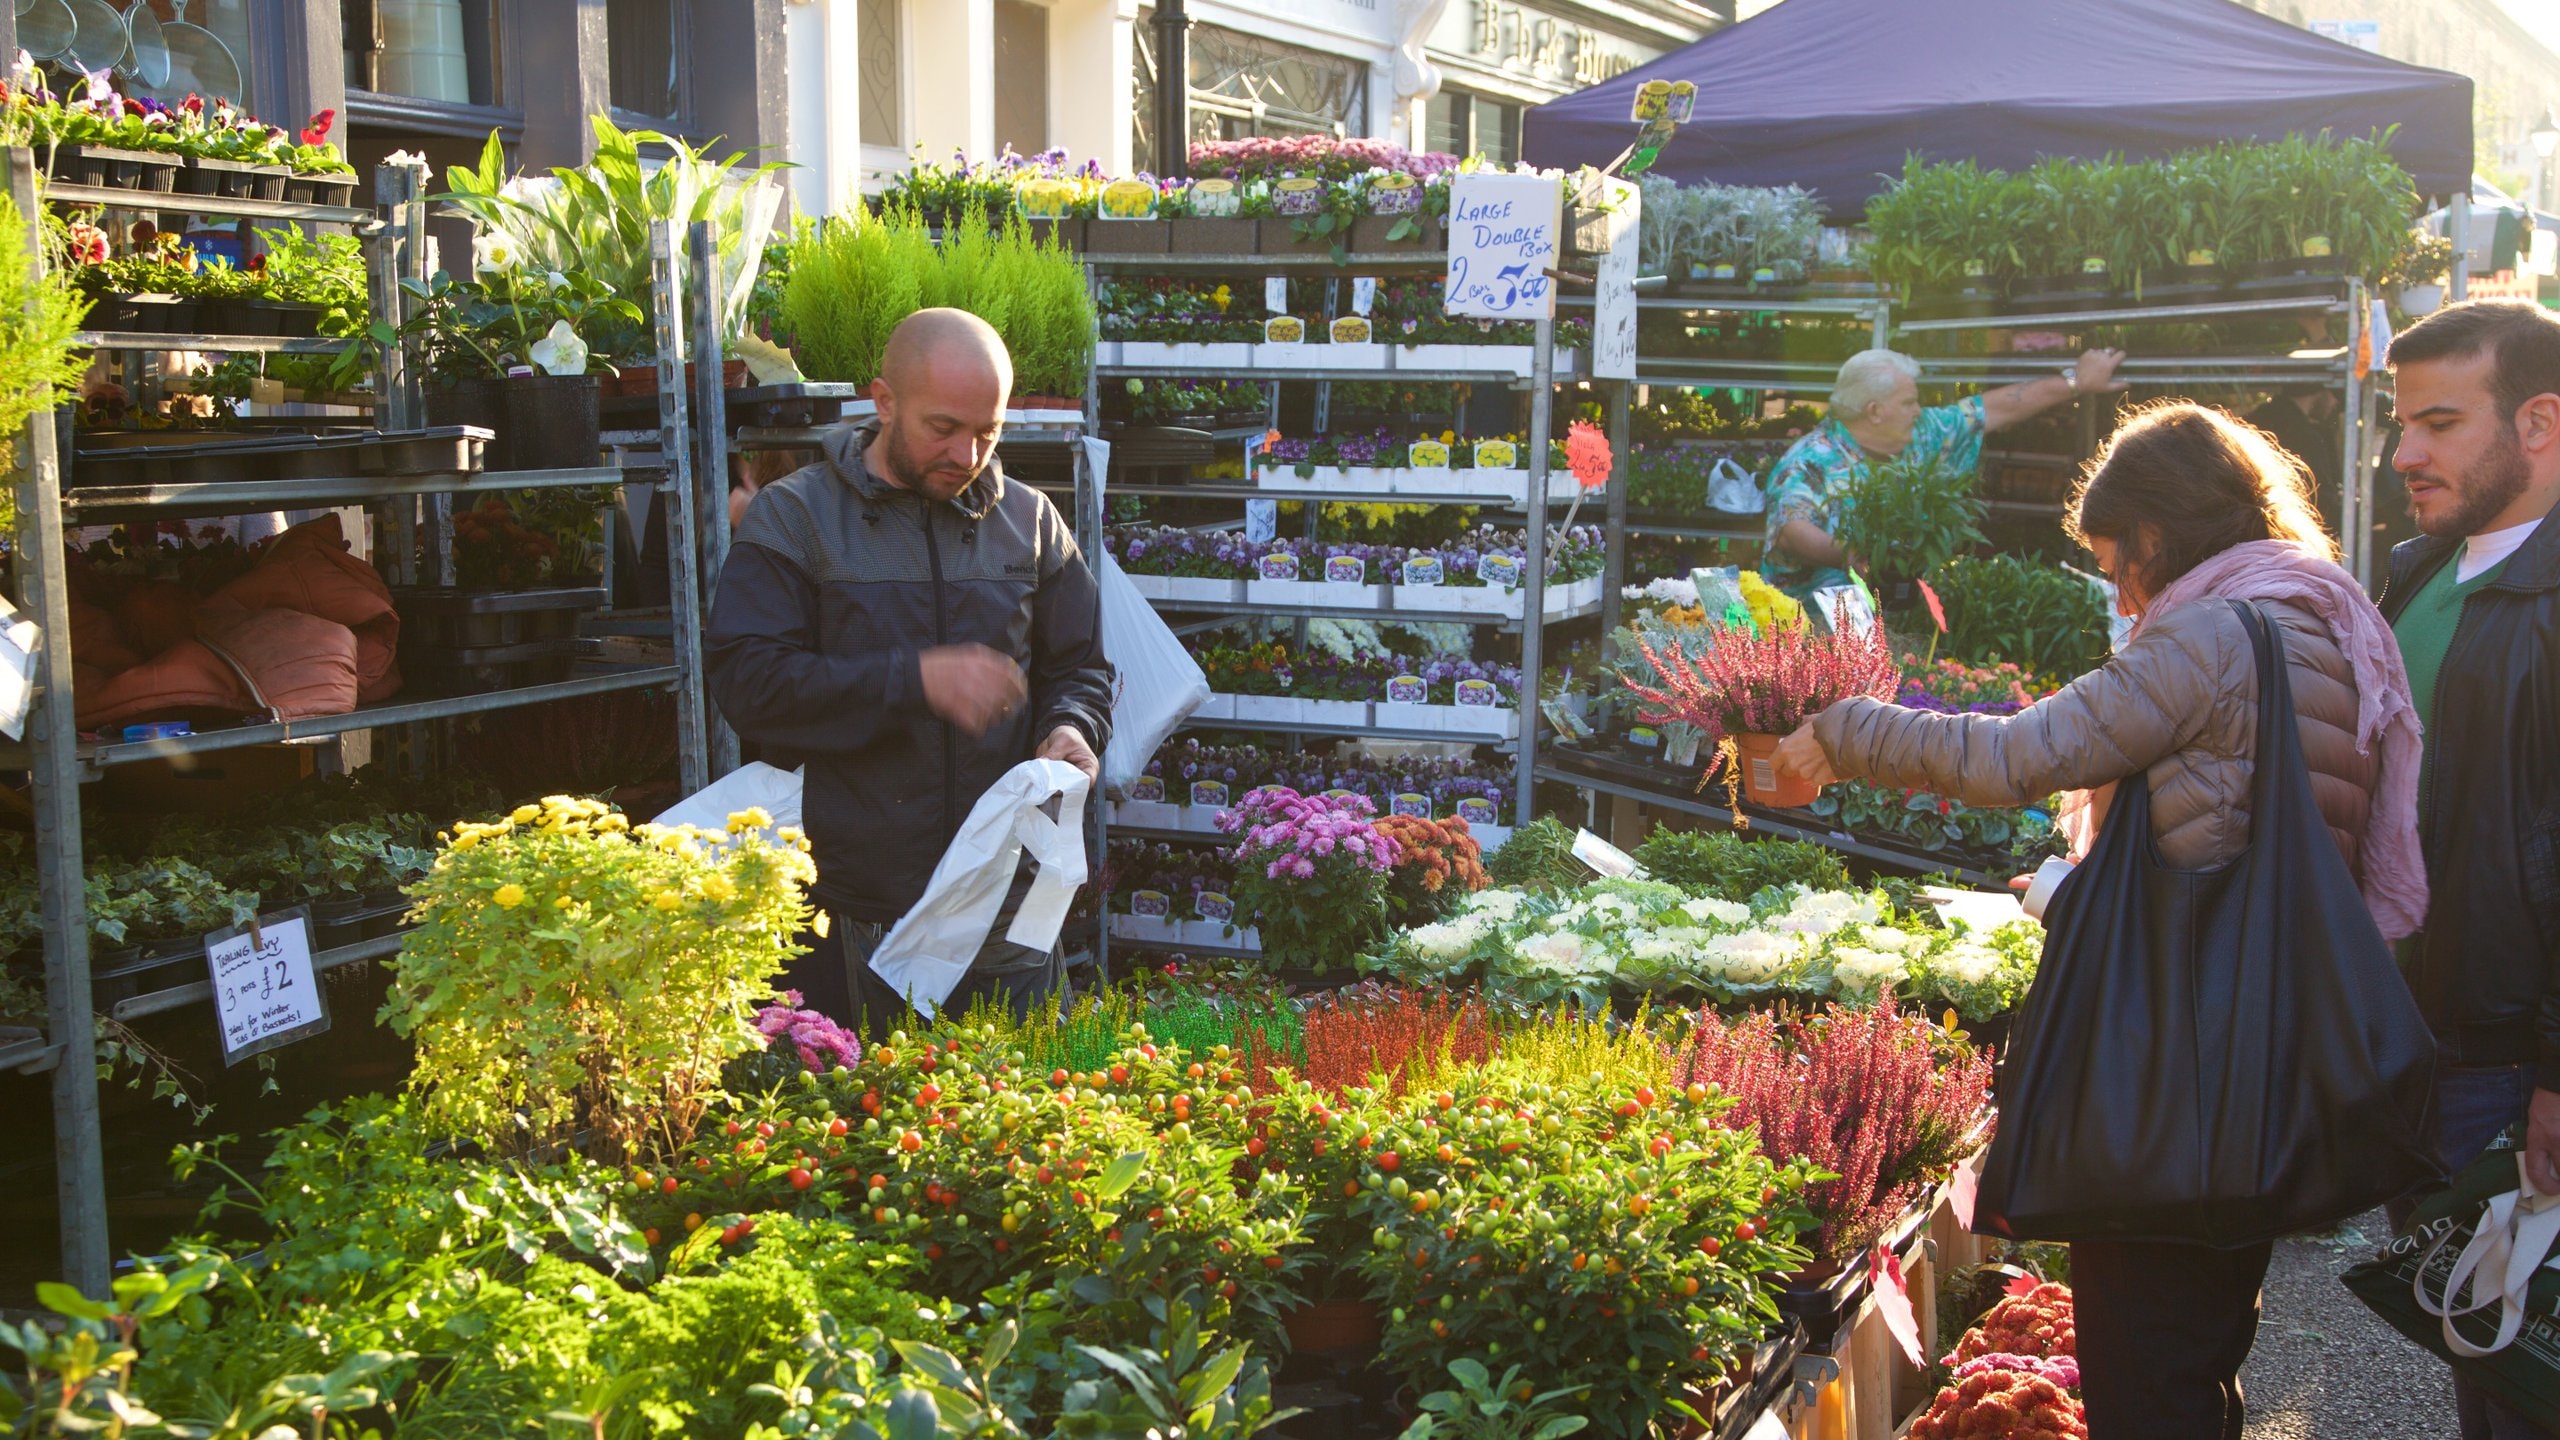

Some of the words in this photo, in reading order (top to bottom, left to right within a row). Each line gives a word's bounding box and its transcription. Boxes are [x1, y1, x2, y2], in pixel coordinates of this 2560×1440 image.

[1456, 197, 1512, 222] LARGE
[1473, 225, 1545, 249] DOUBLE
[1447, 256, 1468, 303] 2
[226, 988, 236, 1012] 3
[261, 961, 293, 1000] £2
[247, 1014, 257, 1028] for
[261, 1003, 290, 1019] Winter
